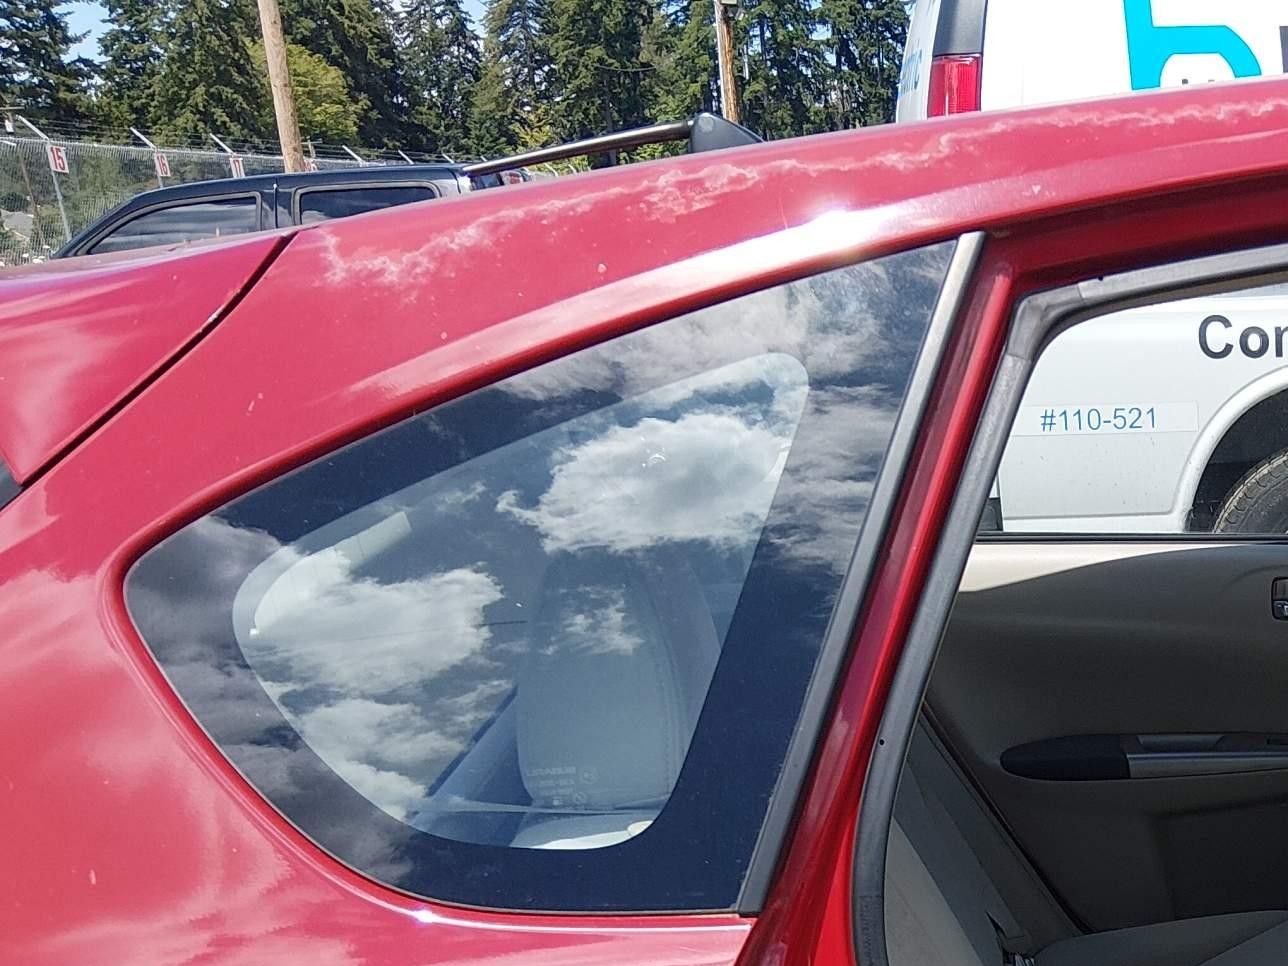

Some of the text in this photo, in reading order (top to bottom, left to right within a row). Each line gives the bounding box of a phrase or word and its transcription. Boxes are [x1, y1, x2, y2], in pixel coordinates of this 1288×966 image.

[50, 147, 66, 171] 15
[157, 154, 169, 176] 16
[1039, 406, 1158, 432] #110-521
